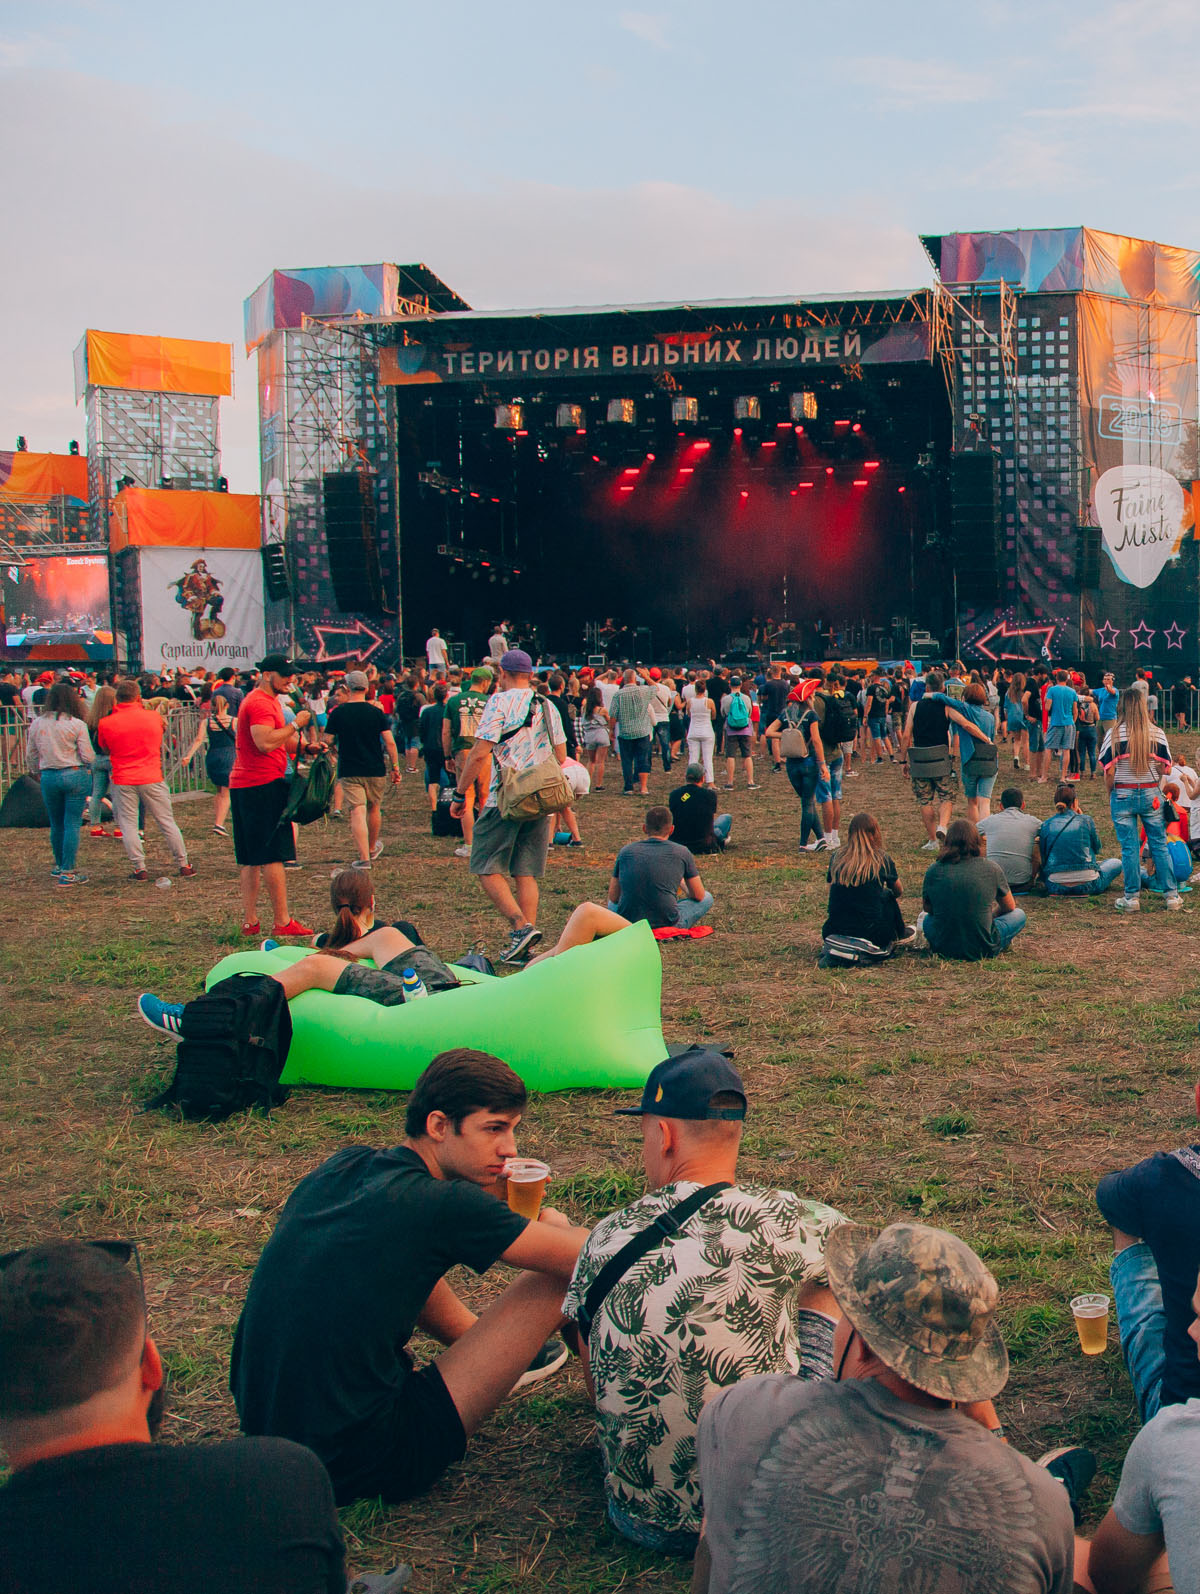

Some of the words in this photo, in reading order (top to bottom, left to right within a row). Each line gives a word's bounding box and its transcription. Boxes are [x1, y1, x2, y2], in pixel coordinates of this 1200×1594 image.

[443, 346, 600, 375] ТЕРИТОРІЯ
[612, 339, 742, 368] ВІЛЬНИХ
[753, 330, 863, 363] ЛЮДЕЙ
[1108, 403, 1173, 438] 2018
[1110, 480, 1166, 523] Faine
[1114, 515, 1173, 552] Misto
[160, 642, 204, 661] Captain
[204, 641, 249, 660] Morgan
